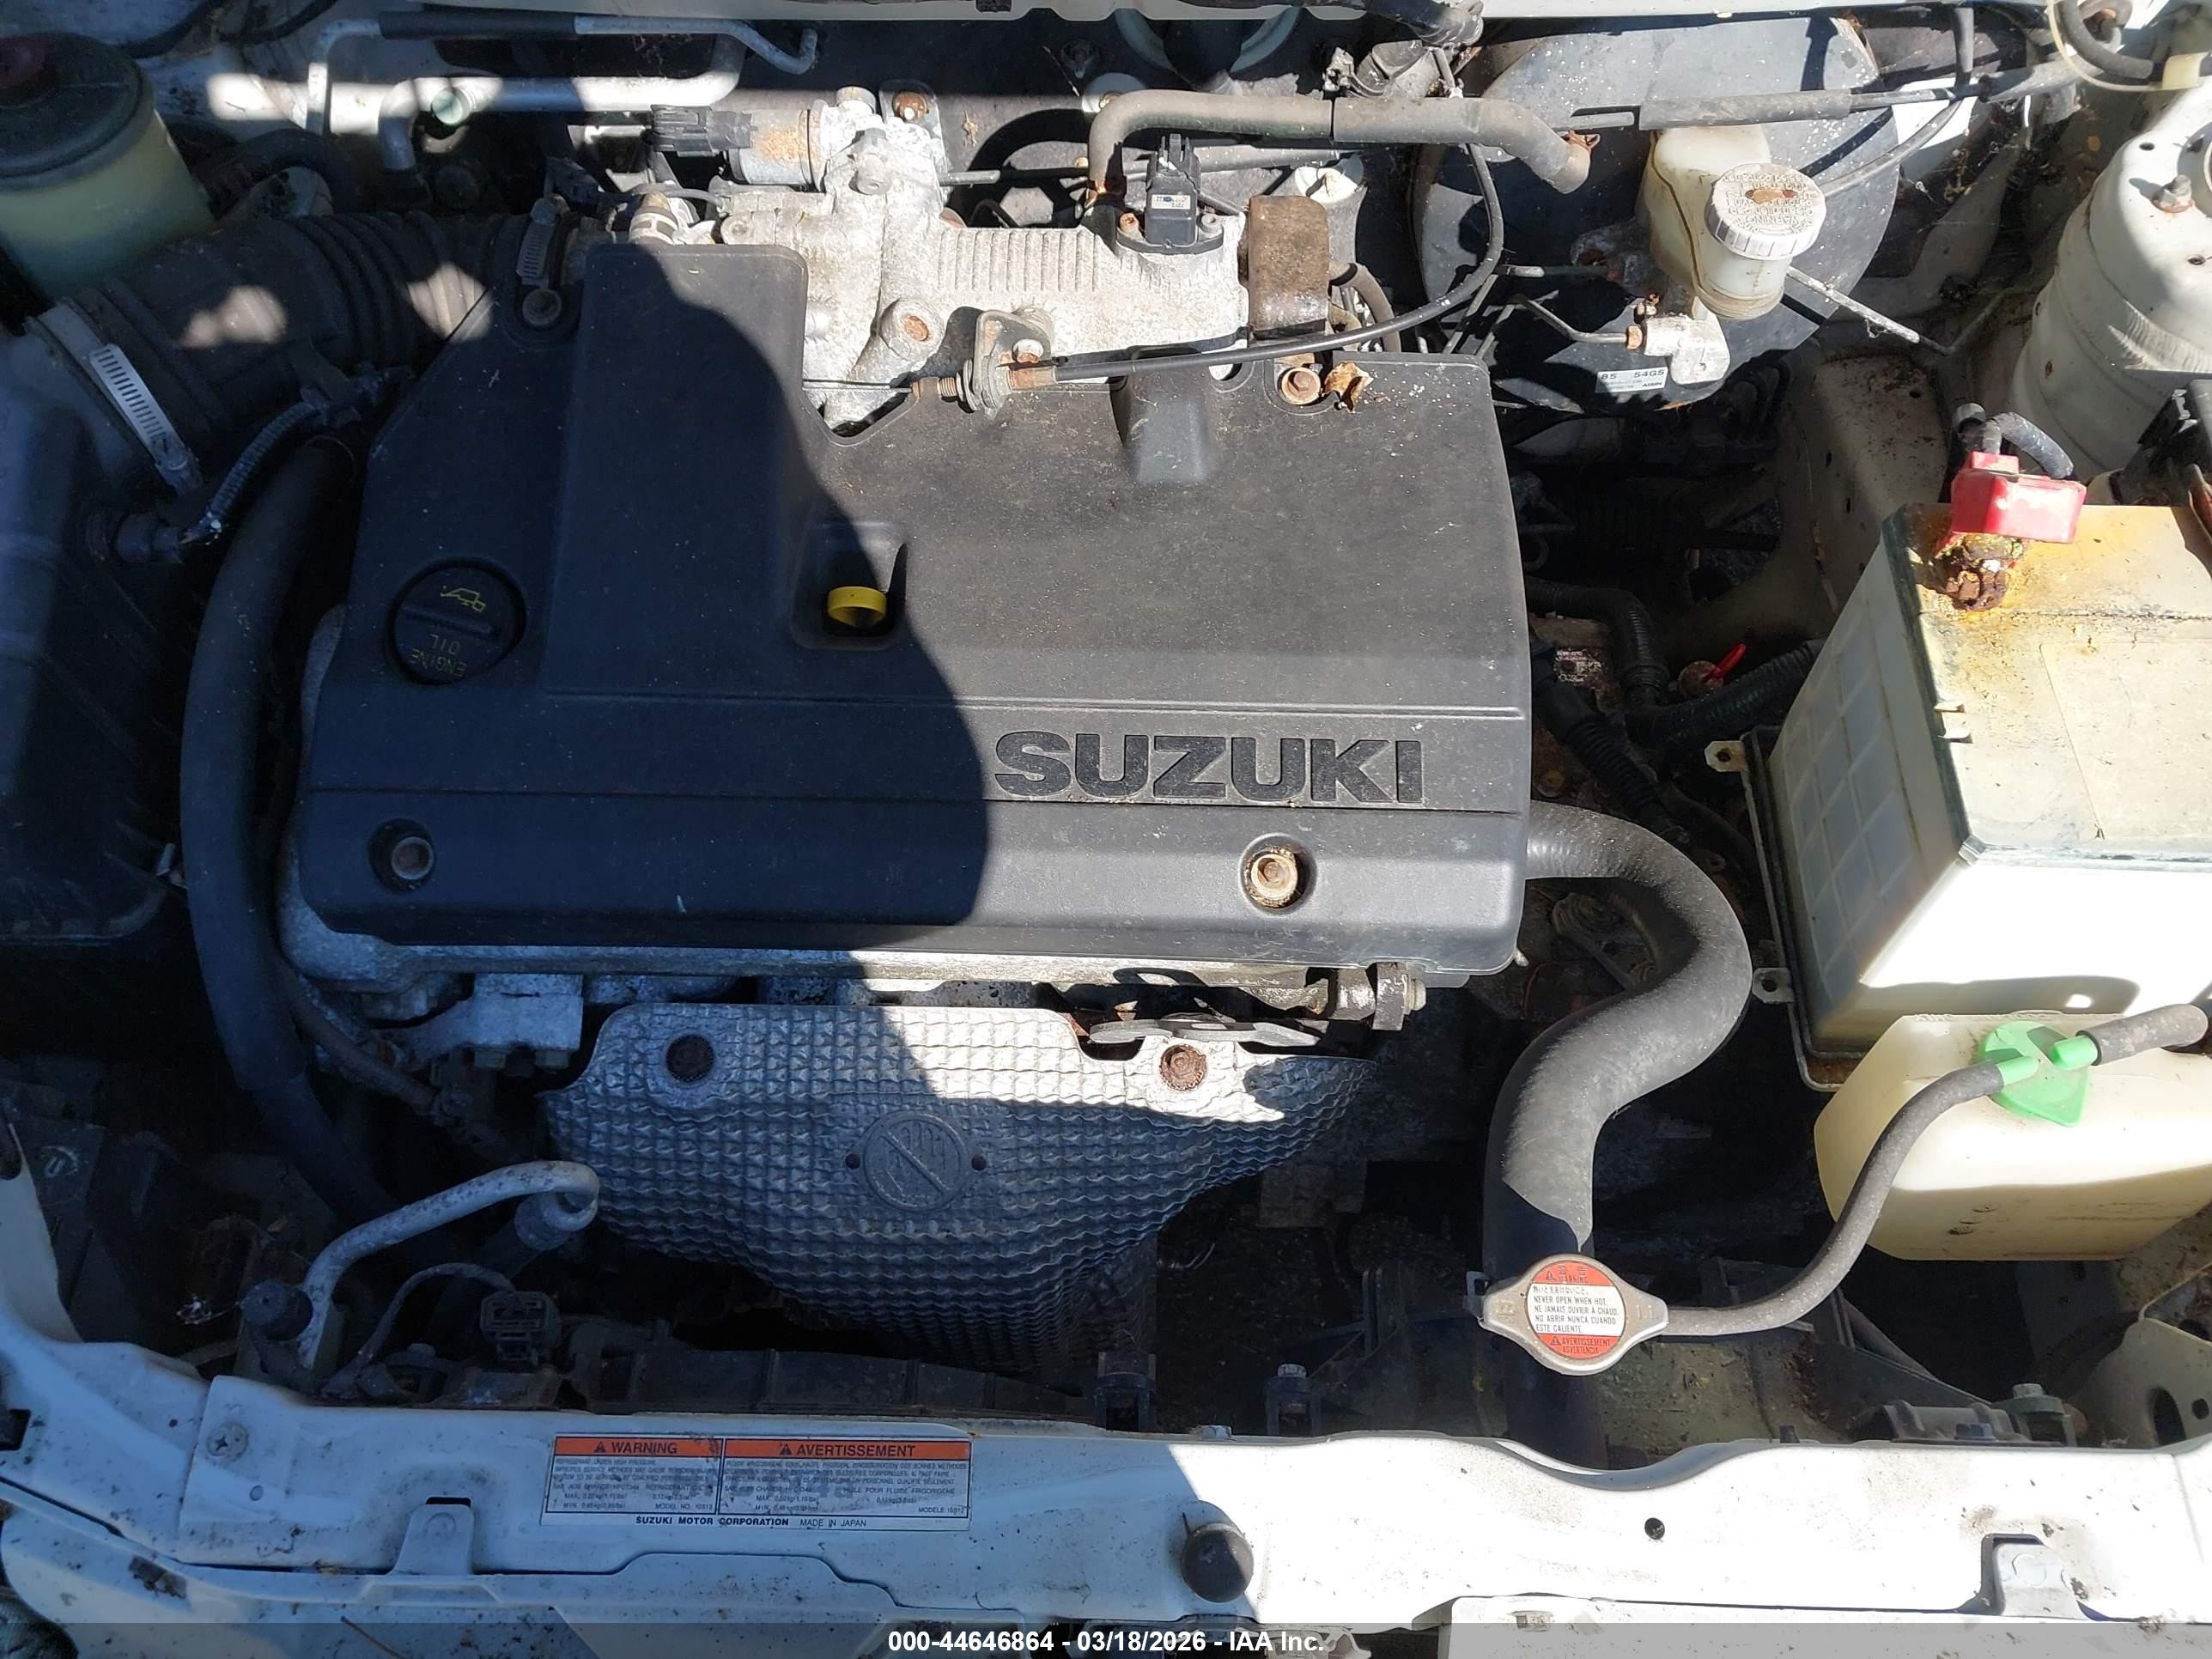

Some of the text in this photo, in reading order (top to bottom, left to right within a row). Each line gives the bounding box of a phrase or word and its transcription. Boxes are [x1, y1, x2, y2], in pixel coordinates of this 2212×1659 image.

[430, 633, 461, 655] OIL
[411, 648, 467, 678] ENGINE
[994, 730, 1424, 804] SUZUKI
[1590, 1316, 1616, 1325] CUANDO
[1561, 1336, 1611, 1346] AVERTISSEMENT
[611, 1442, 678, 1454] WARNING
[796, 1443, 916, 1457] AVERTISSEMENT
[635, 1516, 867, 1528] SUZUKI MOTOR CORPORATION MADE IN JAPAN
